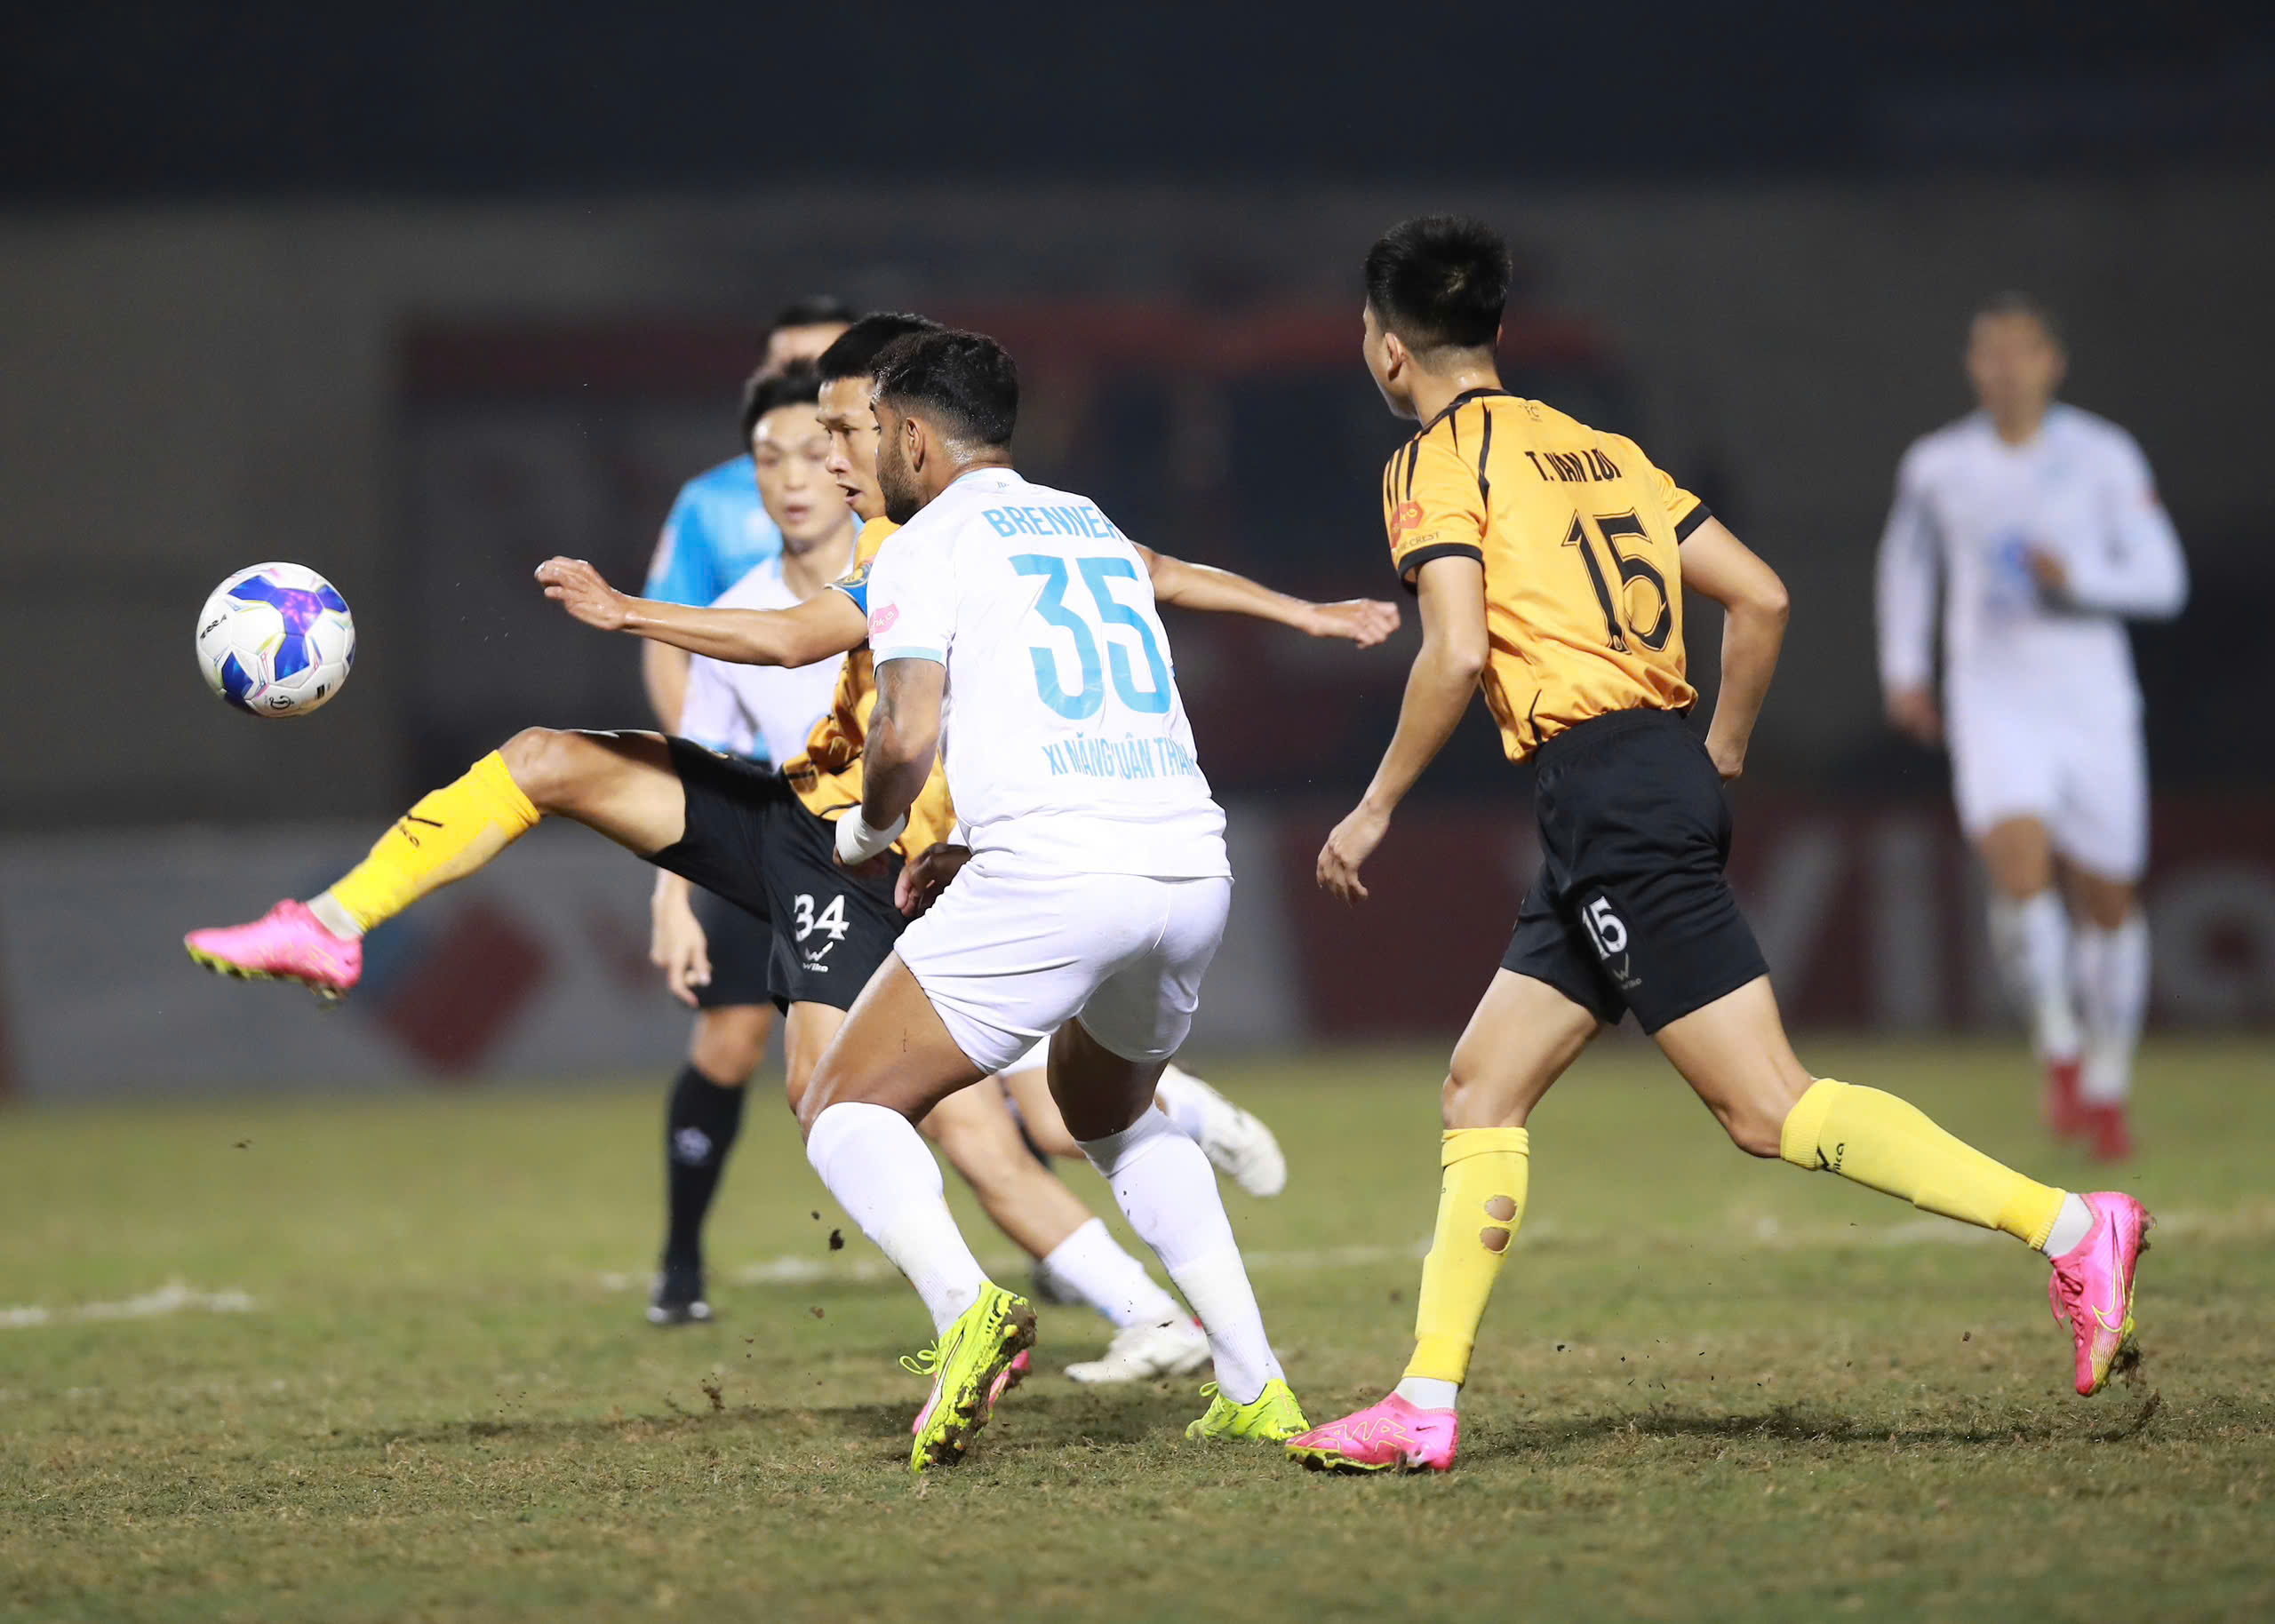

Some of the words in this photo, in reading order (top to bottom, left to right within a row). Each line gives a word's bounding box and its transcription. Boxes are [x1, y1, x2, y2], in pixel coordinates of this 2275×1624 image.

[1561, 507, 1674, 656] 15
[1007, 553, 1171, 720] 35
[1042, 744, 1069, 776] XI
[794, 893, 850, 943] 34
[1582, 896, 1628, 960] 15
